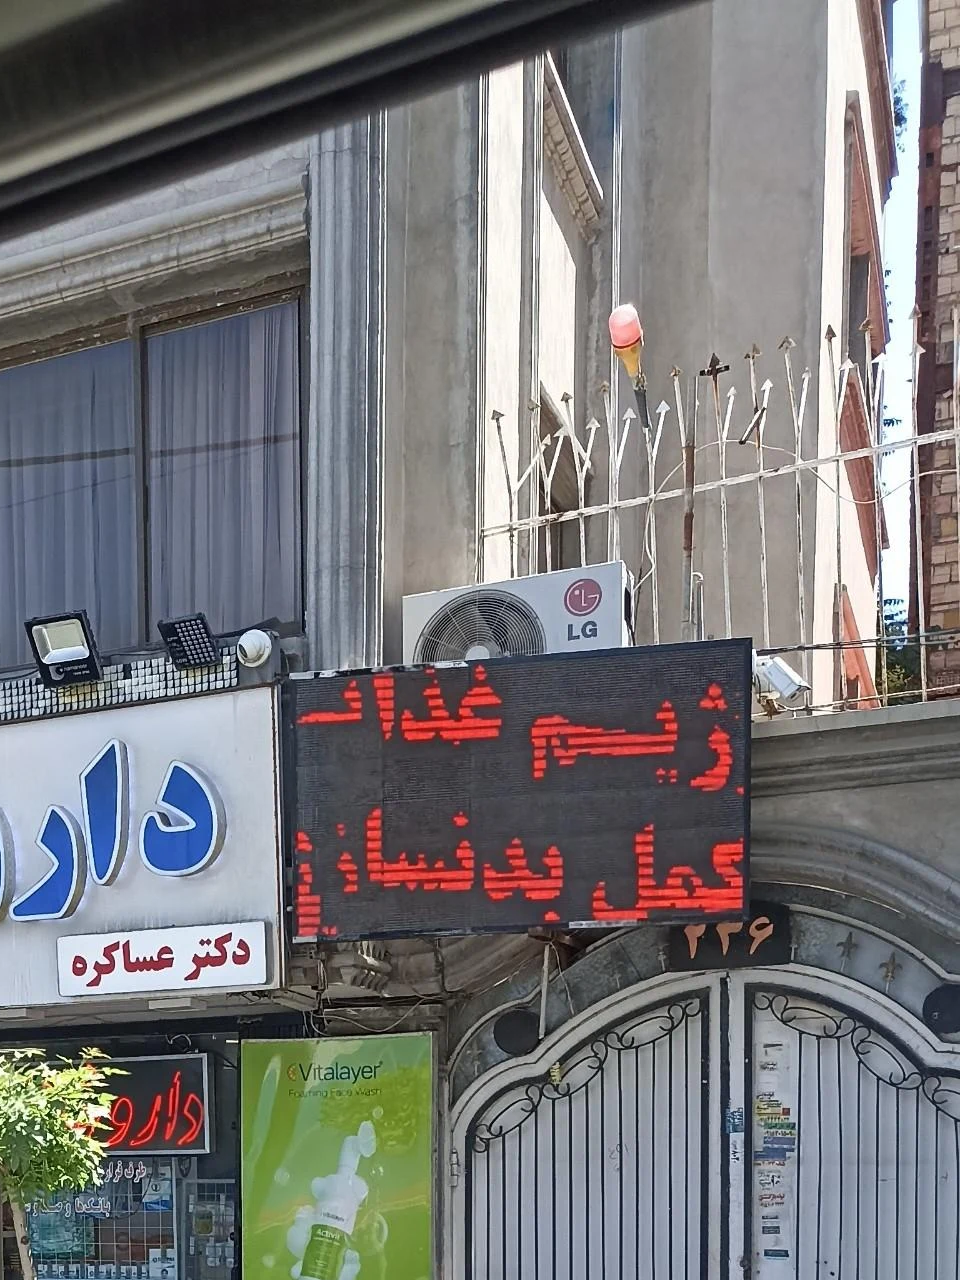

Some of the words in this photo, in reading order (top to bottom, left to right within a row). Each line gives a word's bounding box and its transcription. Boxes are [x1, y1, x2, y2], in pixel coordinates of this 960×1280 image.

[568, 621, 598, 641] LG
[71, 941, 175, 988] عساکره
[184, 932, 251, 982] دکتر
[298, 1061, 381, 1085] Vitalayer
